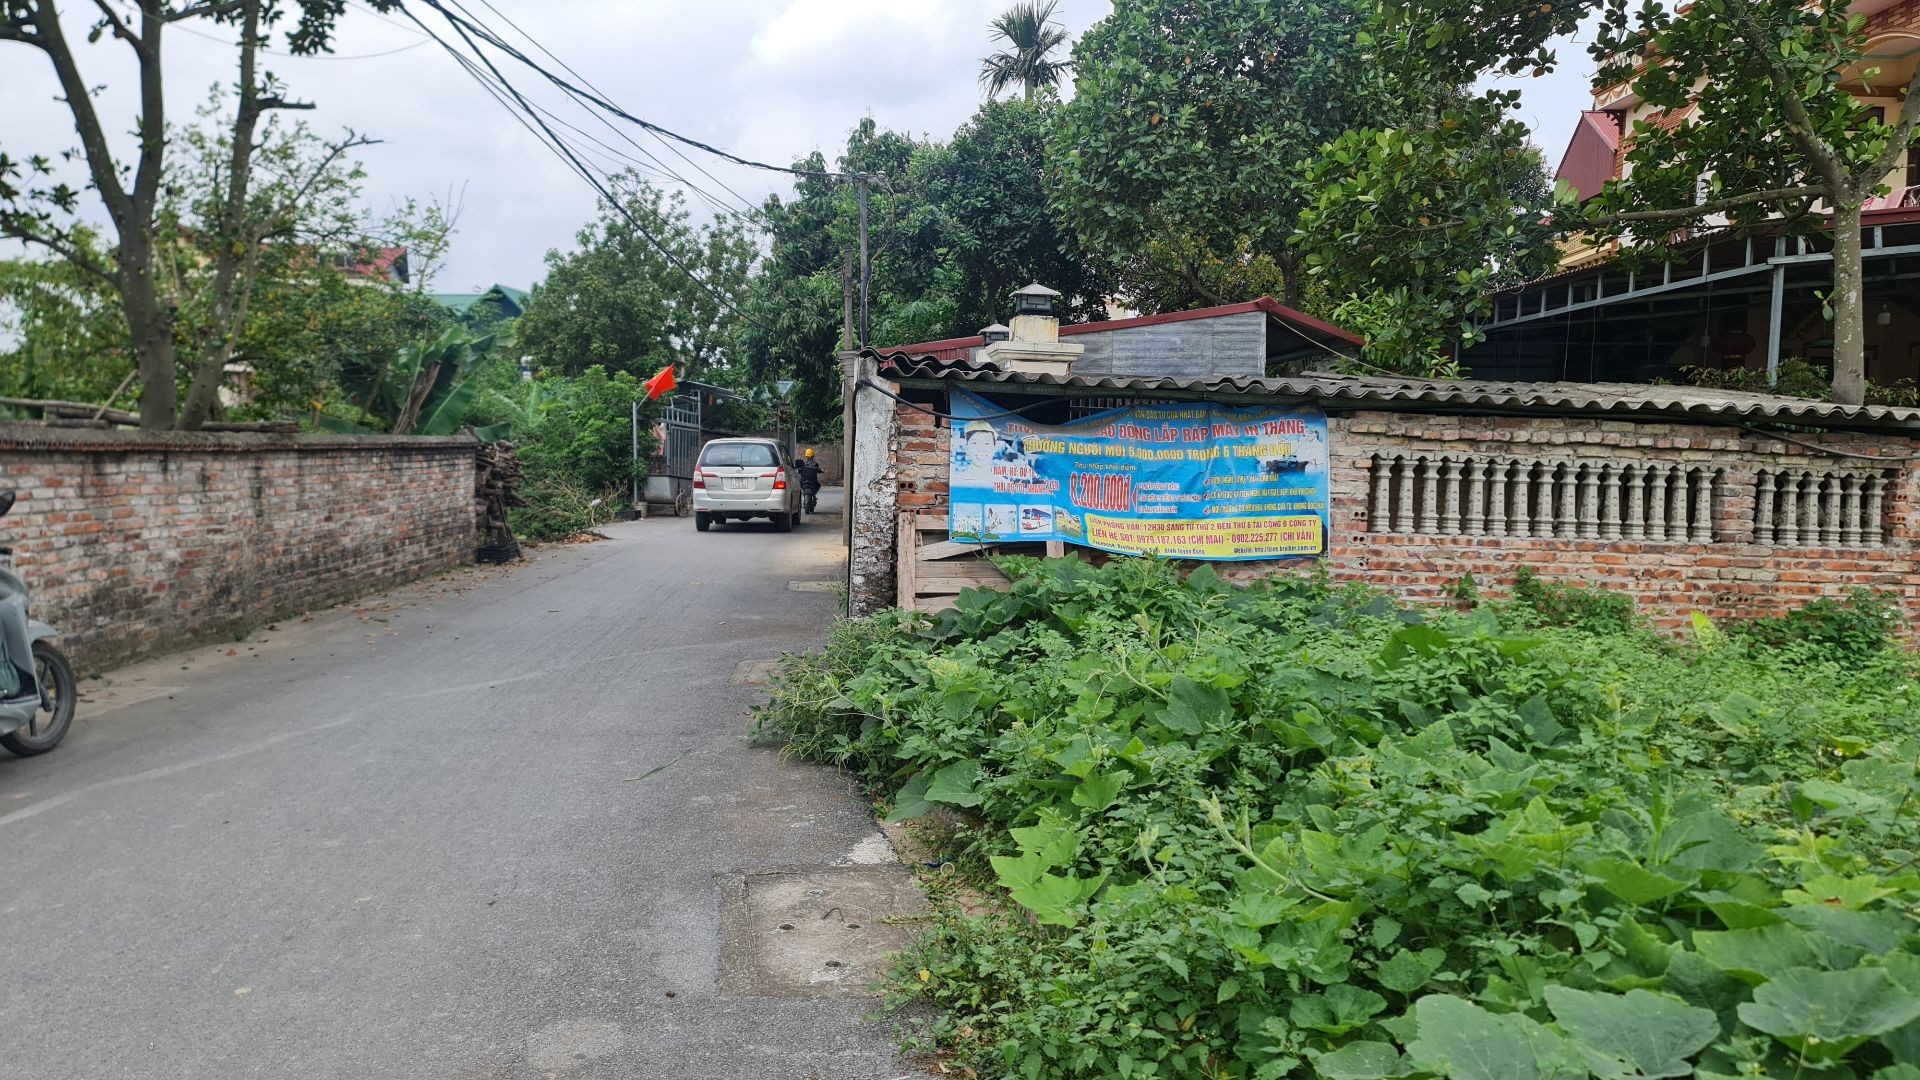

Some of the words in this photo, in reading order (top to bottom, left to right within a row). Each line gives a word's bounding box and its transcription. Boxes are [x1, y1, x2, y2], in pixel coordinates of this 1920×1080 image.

[1118, 421, 1151, 442] ĐỘNG
[1144, 523, 1165, 532] 12H30
[1210, 523, 1215, 531] 2
[1309, 519, 1317, 527] TY
[1231, 532, 1278, 544] 0902.225.277
